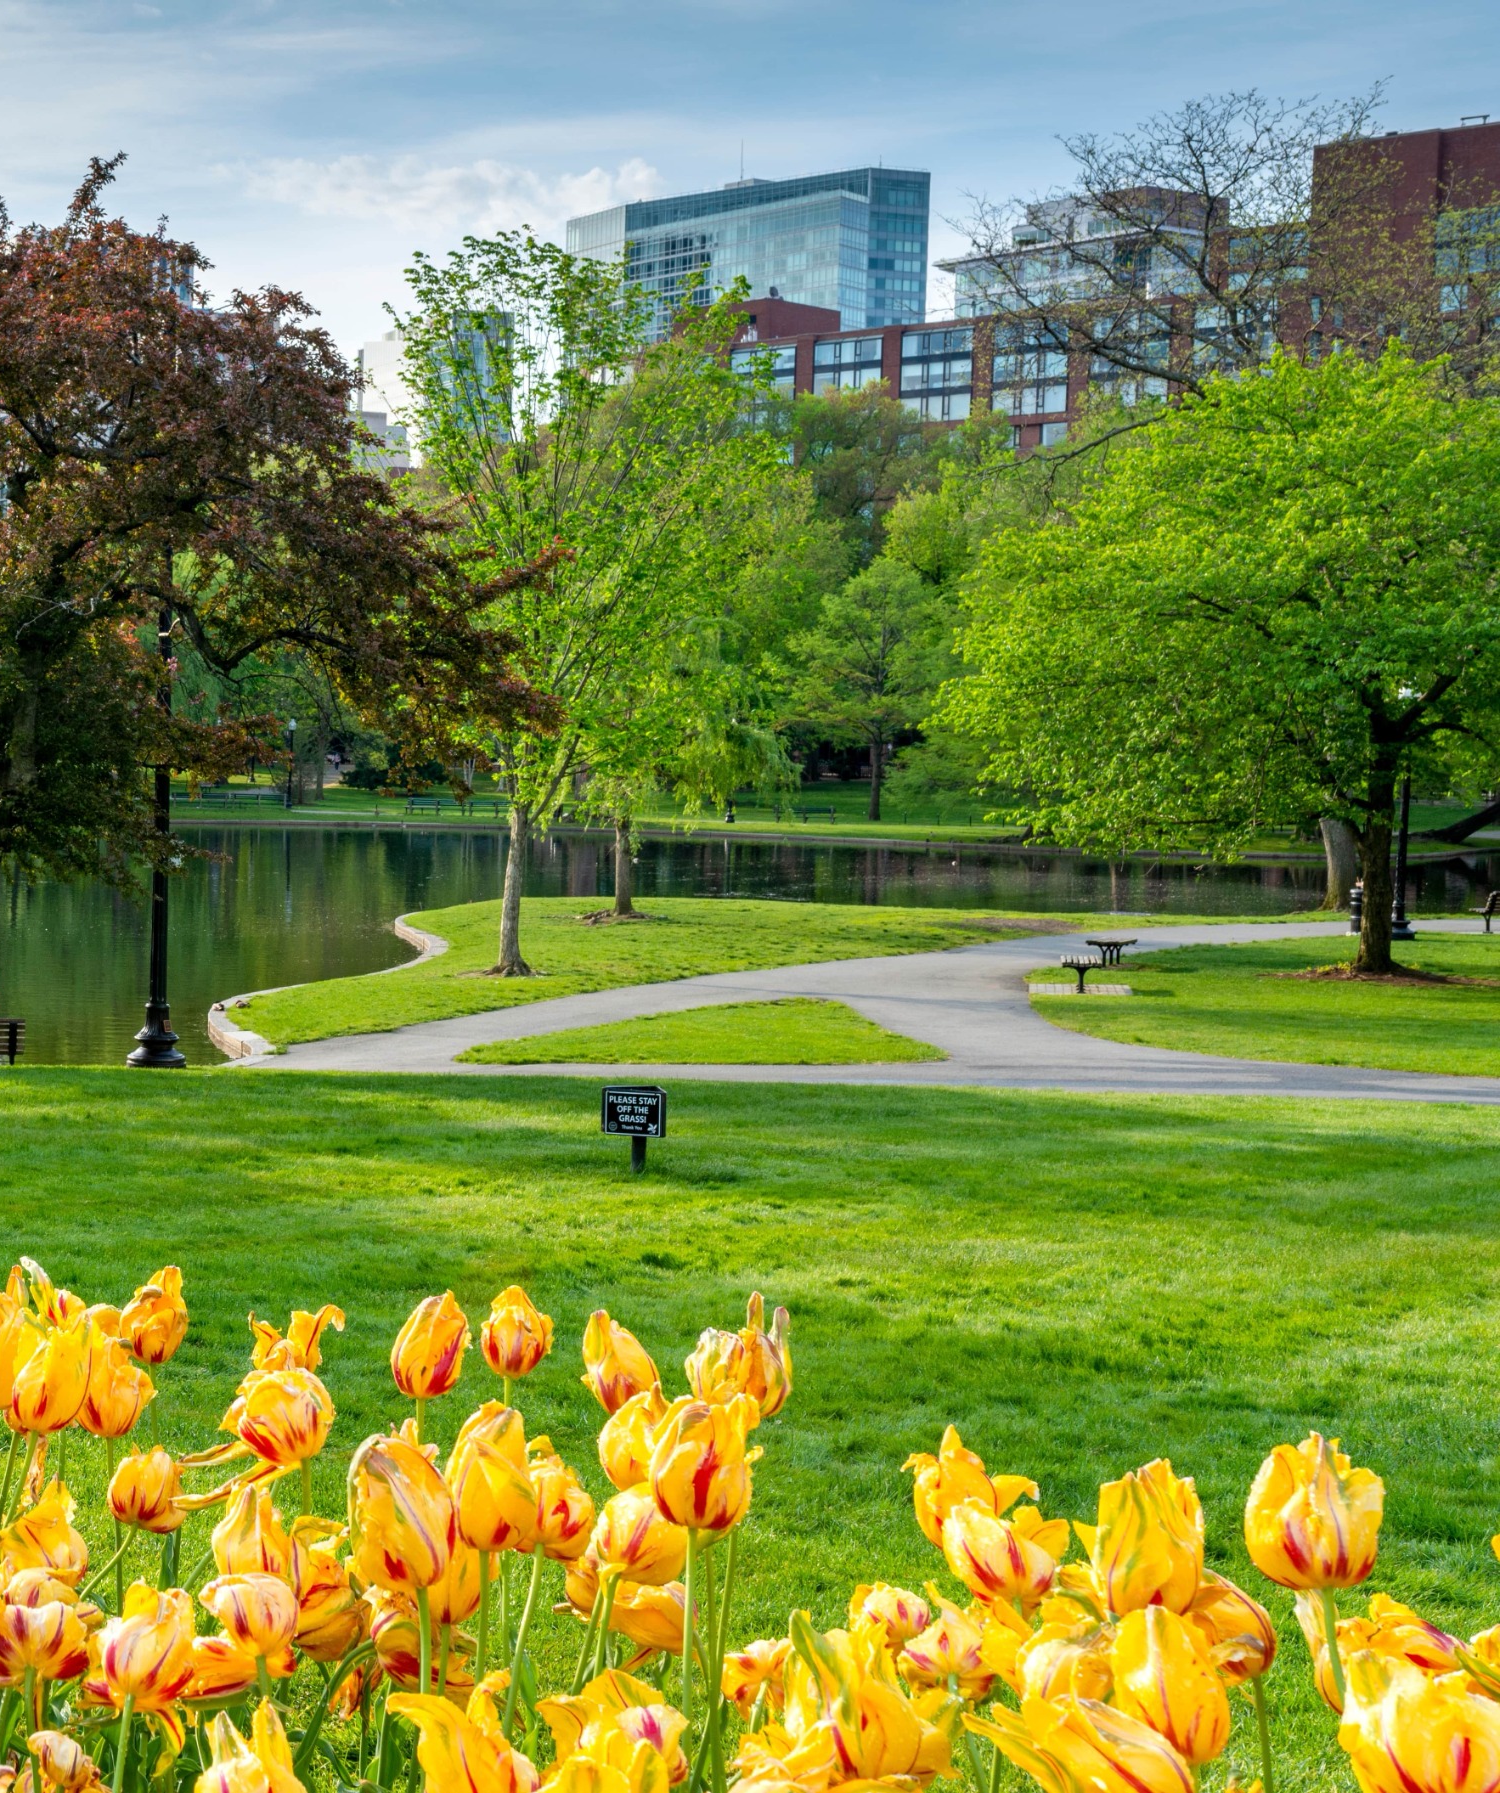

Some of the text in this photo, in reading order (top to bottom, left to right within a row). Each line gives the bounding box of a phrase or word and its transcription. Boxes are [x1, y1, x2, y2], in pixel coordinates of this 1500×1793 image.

[609, 1096, 657, 1105] PLEASE STAY
[633, 1106, 649, 1114] THE
[619, 1114, 646, 1123] GRASS!
